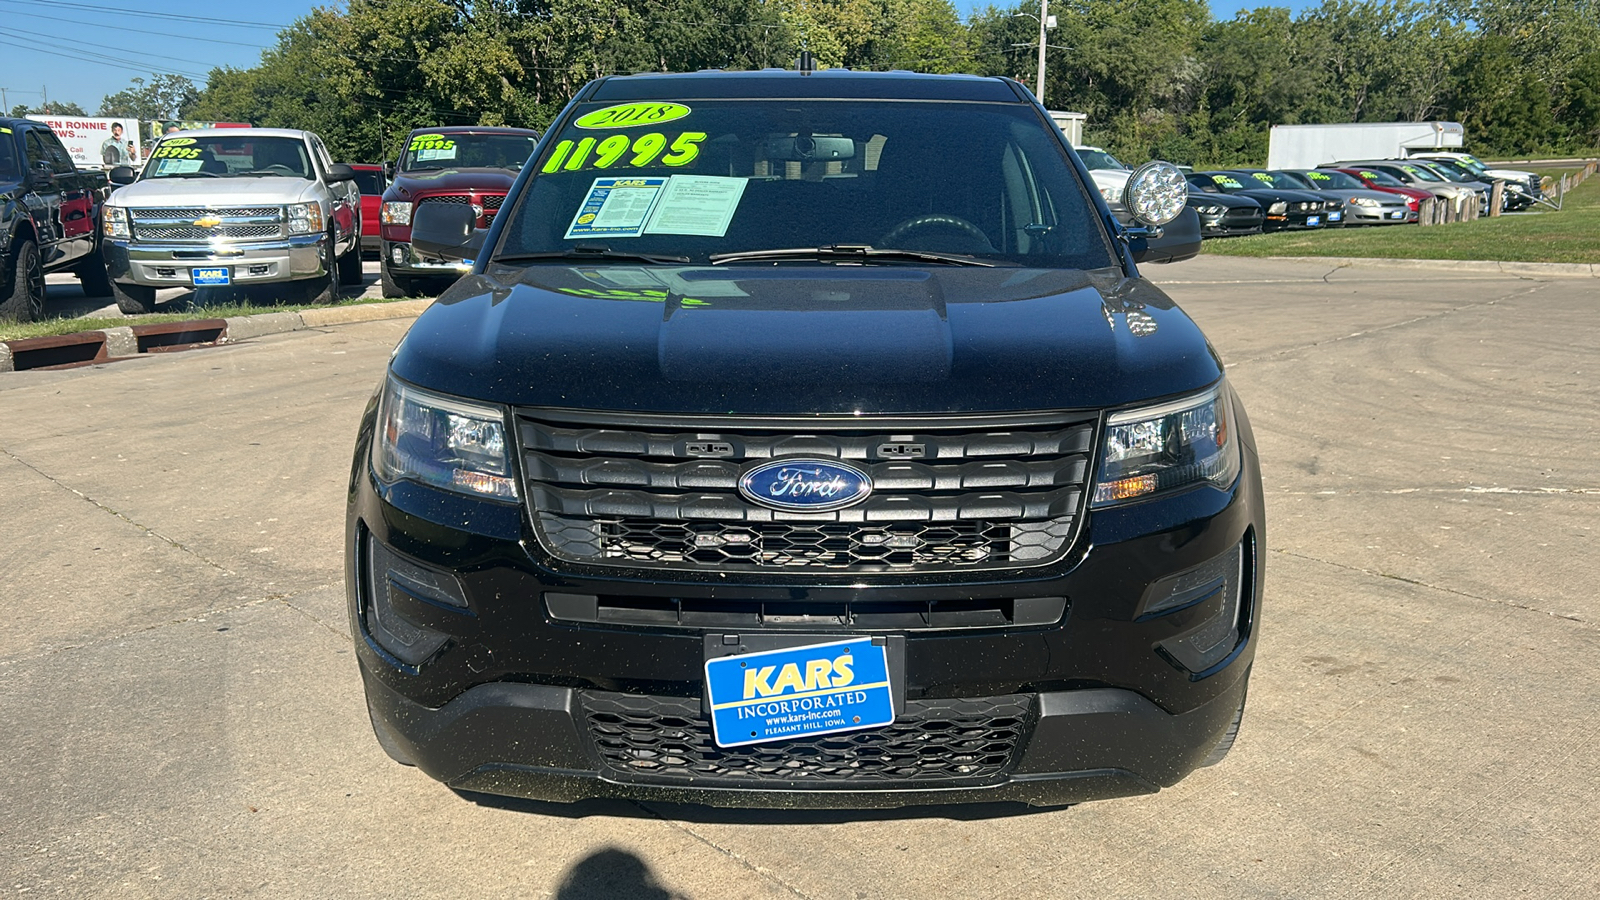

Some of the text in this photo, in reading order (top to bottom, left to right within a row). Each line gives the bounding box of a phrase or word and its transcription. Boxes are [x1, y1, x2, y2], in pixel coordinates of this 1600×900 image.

[590, 105, 675, 126] 2018
[66, 121, 107, 130] RONNIE
[152, 147, 203, 159] 13995
[408, 140, 455, 151] 21995
[542, 131, 708, 174] 11995
[612, 179, 647, 187] KARS
[769, 467, 840, 498] Ford
[743, 654, 855, 700] KARS
[737, 691, 868, 720] INCORPORATED
[766, 708, 842, 726] www.kars-inc.com
[765, 725, 801, 736] PLEASANT
[825, 719, 846, 728] IOWA
